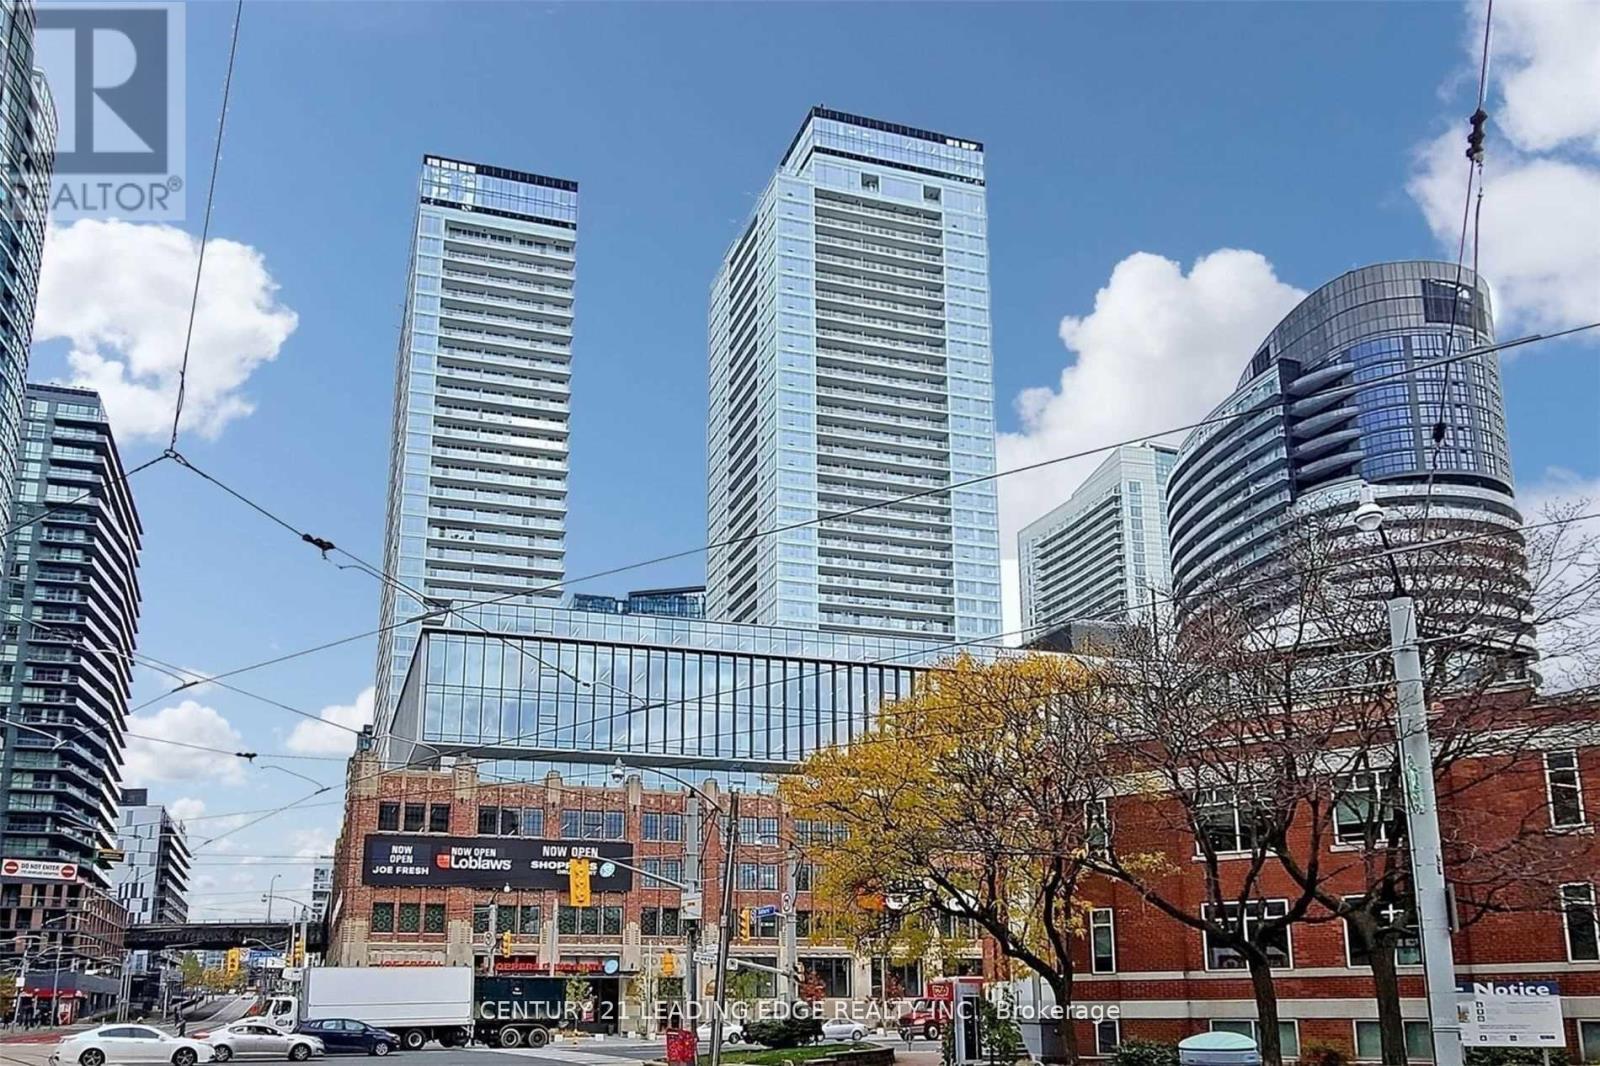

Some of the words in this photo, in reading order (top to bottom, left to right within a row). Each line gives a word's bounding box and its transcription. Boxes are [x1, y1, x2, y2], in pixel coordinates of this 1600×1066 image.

[391, 845, 413, 854] NOW
[451, 847, 472, 856] NOW
[473, 848, 497, 857] OPEN
[542, 845, 567, 857] NOW
[571, 846, 599, 858] OPEN
[389, 854, 413, 864] OPEN
[450, 855, 512, 870] Loblaws
[530, 860, 598, 870] SHOPPS
[372, 866, 393, 875] JOE
[395, 866, 429, 875] FRESH
[1473, 981, 1550, 996] Notice
